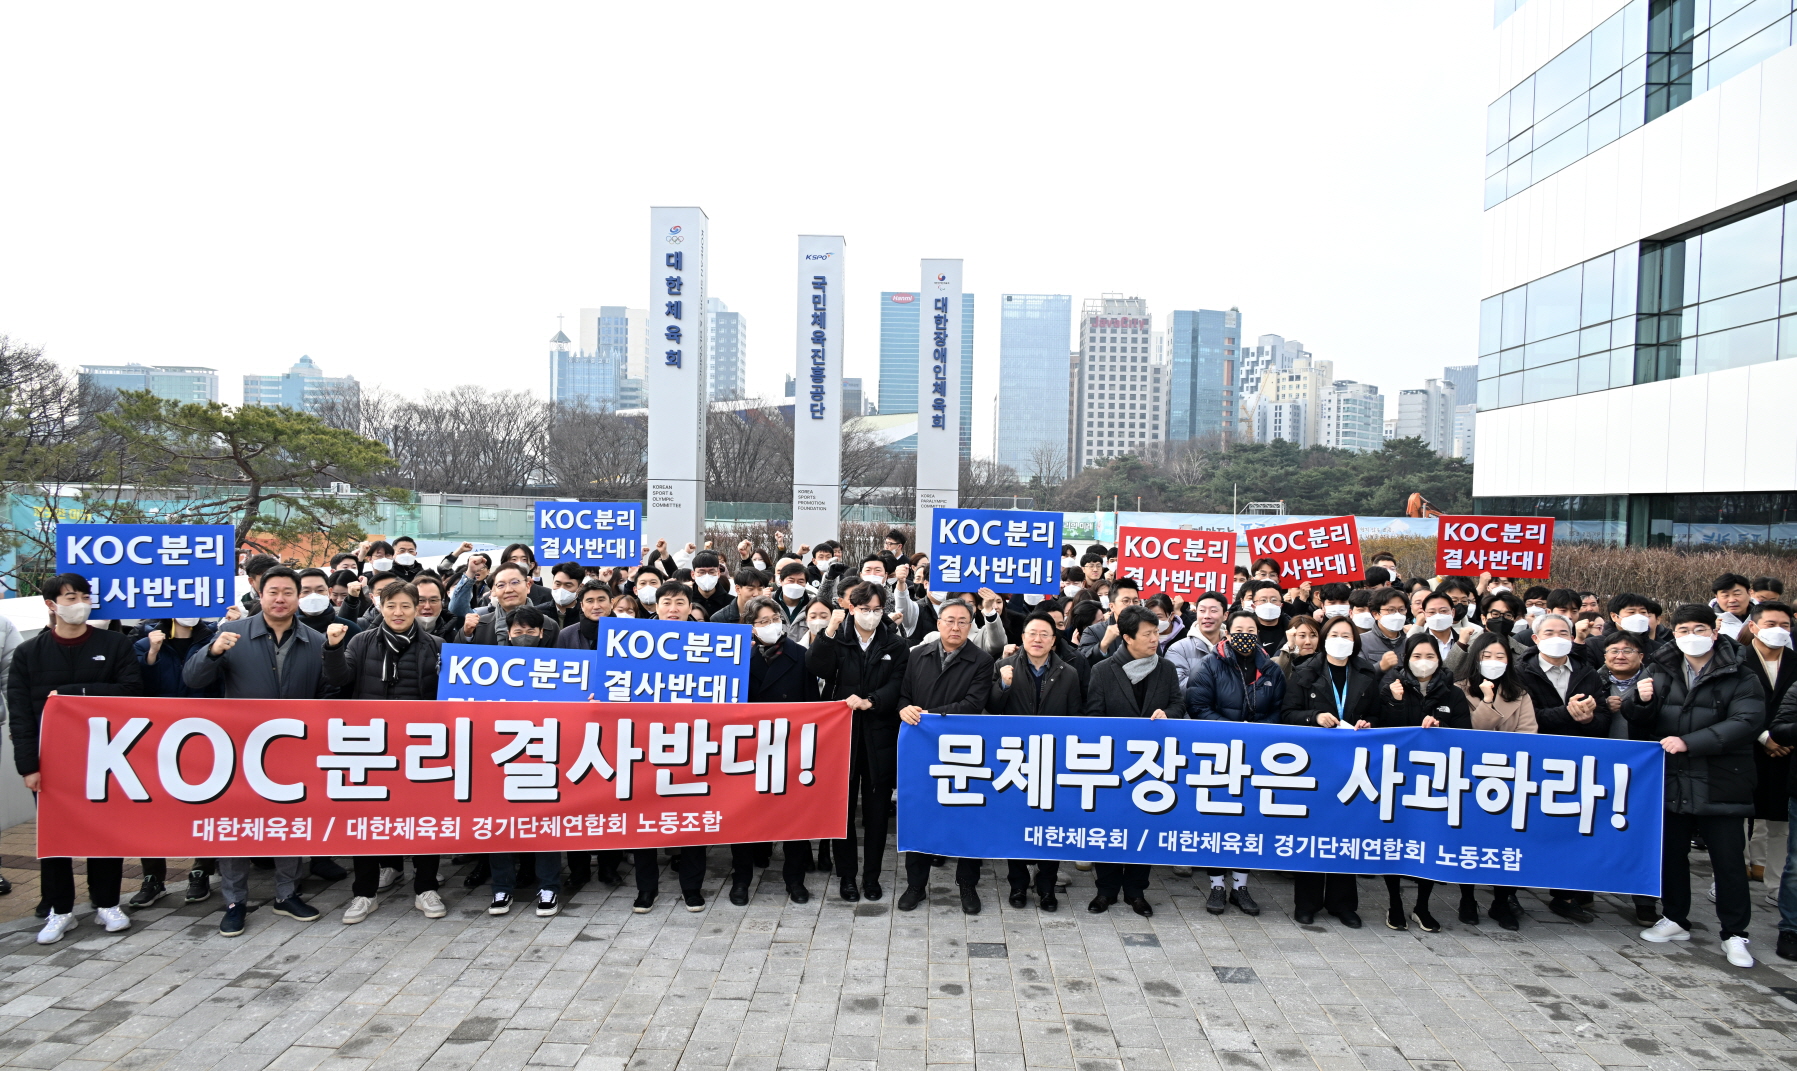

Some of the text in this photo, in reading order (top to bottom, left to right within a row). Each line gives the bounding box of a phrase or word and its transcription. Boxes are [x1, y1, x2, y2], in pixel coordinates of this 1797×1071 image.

[665, 251, 683, 368] 대한체육회
[810, 275, 828, 420] 국민체육진흥공단
[931, 296, 949, 430] 대한장애인체육회
[540, 537, 636, 560] 결사반대!
[937, 554, 1054, 585] 결사반대!
[1280, 553, 1357, 581] 사반대!
[1441, 548, 1545, 571] 결사반대!
[490, 717, 819, 803] 결사반대!
[928, 733, 1632, 836] 문체부장관은 사과하라!
[192, 810, 723, 842] 대한체육회 / 대한체육회 경기단체연합회 노동조합
[1024, 826, 1523, 872] 대한체육회 / 대한체육회 경기단체연합회 노동조합
